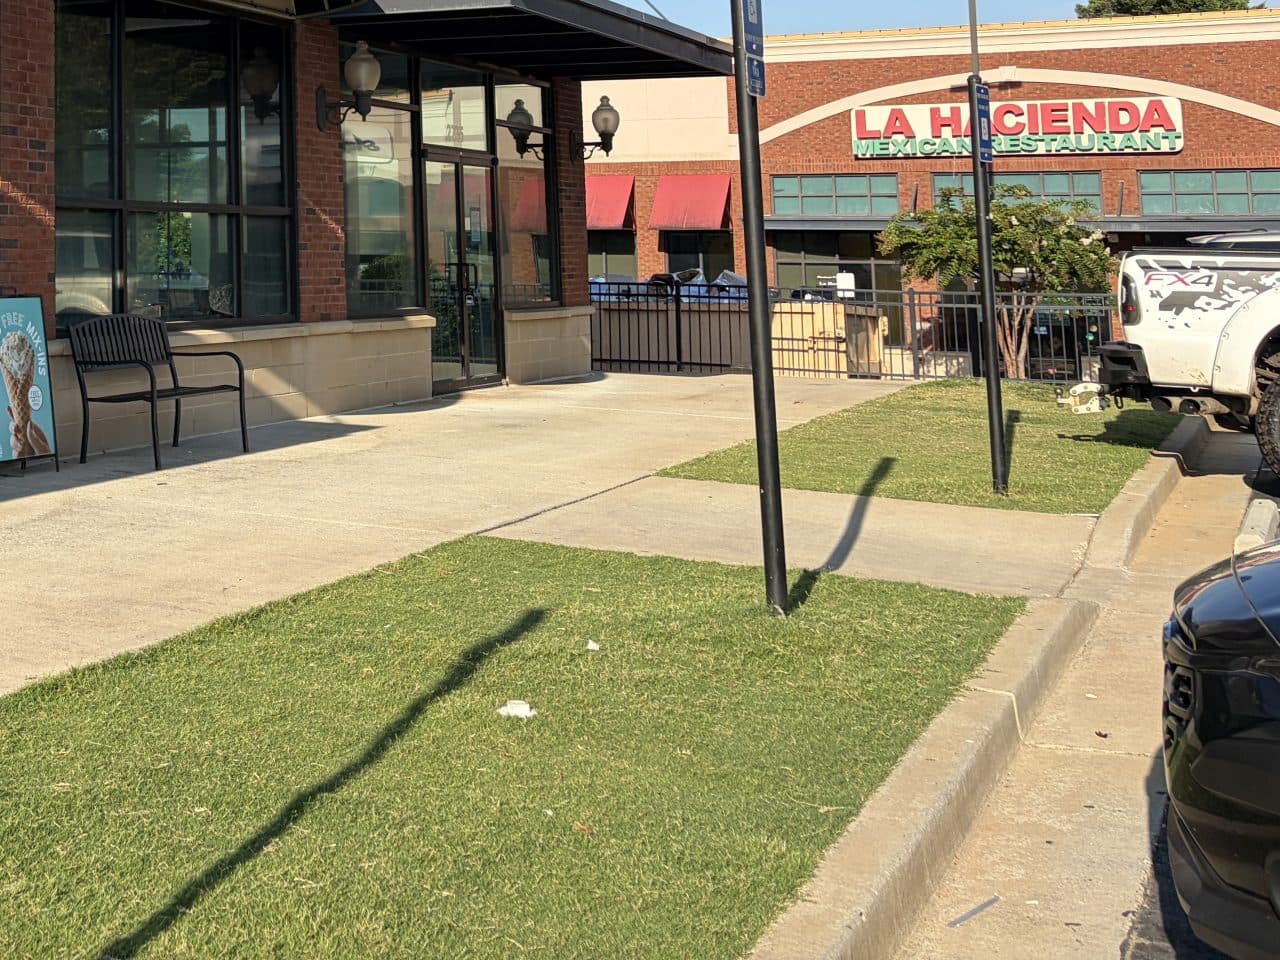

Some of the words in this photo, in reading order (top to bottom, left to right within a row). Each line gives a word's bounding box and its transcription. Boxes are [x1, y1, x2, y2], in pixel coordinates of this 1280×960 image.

[854, 107, 916, 139] LA
[852, 137, 973, 156] MEXICAN
[989, 131, 1183, 154] RESTAURANT
[1144, 272, 1214, 287] FX4
[0, 311, 25, 329] FREE
[25, 321, 46, 377] MIX-INS
